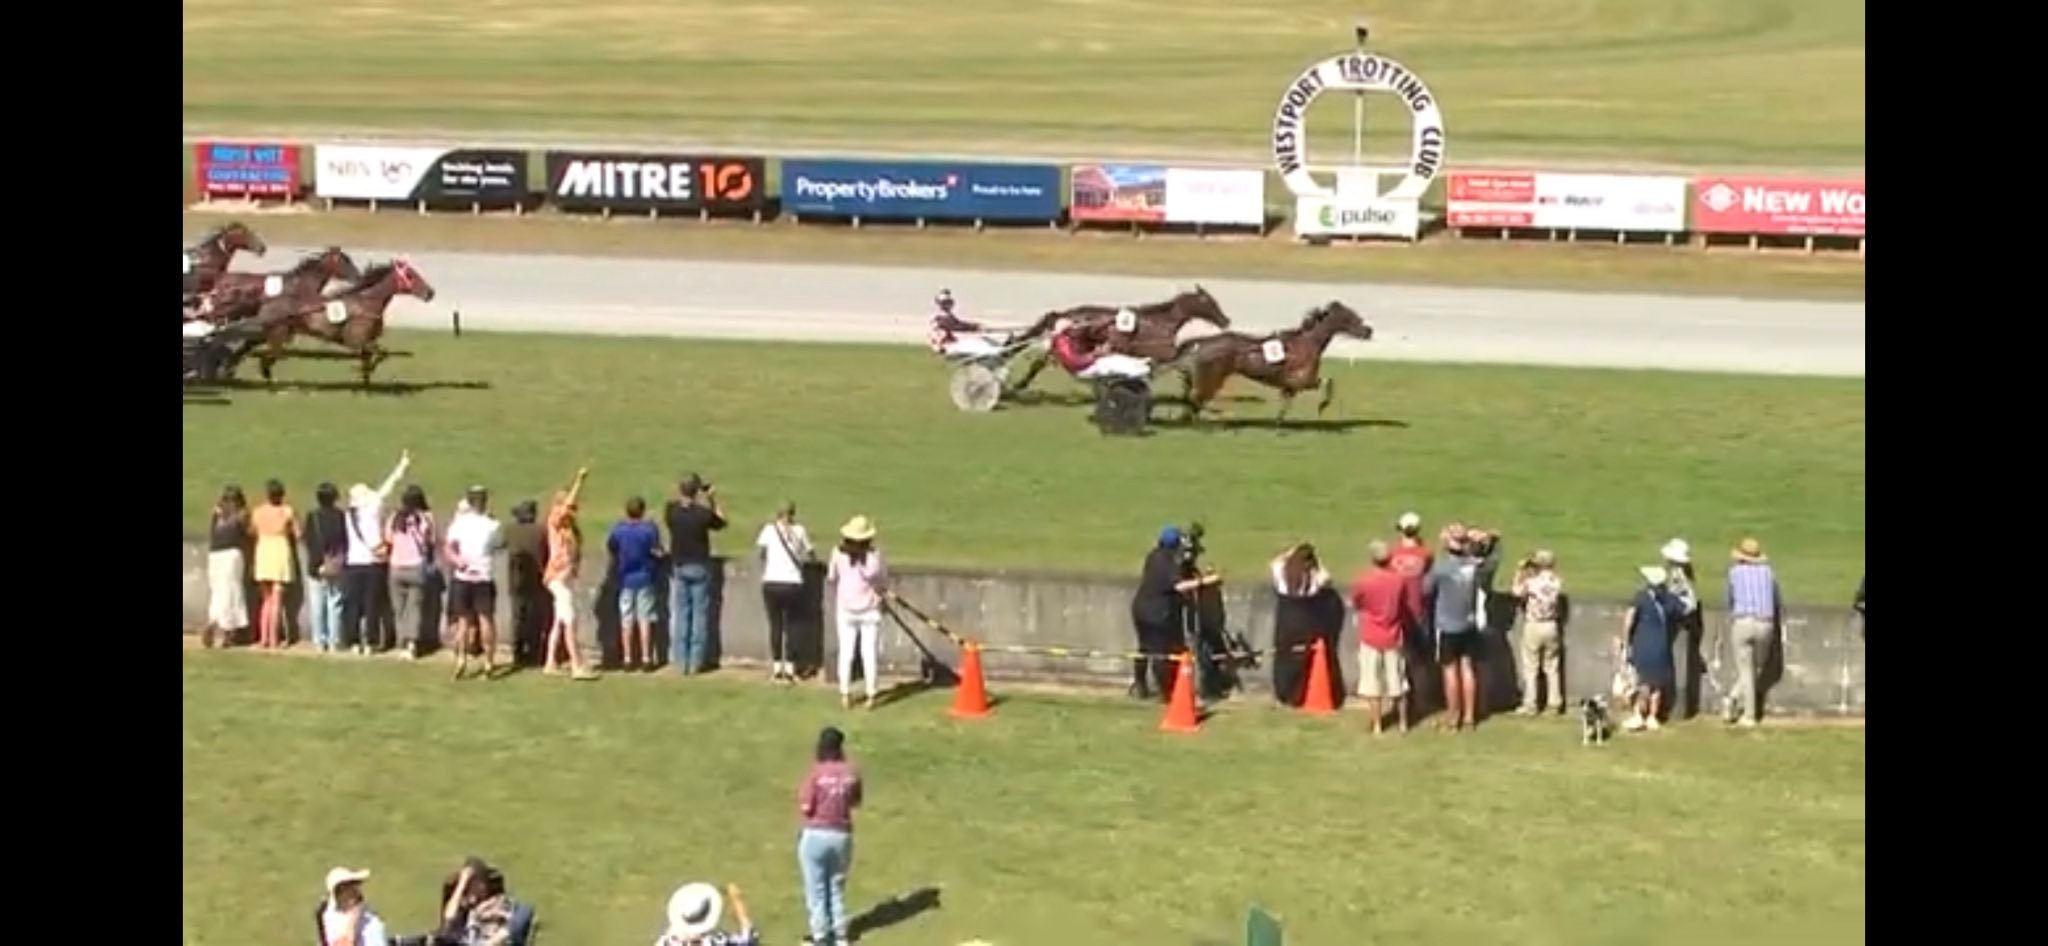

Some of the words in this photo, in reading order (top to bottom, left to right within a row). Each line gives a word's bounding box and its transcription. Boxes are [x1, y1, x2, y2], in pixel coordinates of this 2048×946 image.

[1276, 68, 1325, 175] WESTPORT
[1336, 57, 1432, 112] TROTTING
[1414, 126, 1442, 179] CLUB
[557, 160, 691, 198] MITRE
[700, 163, 753, 200] 10
[1341, 206, 1396, 226] pulse
